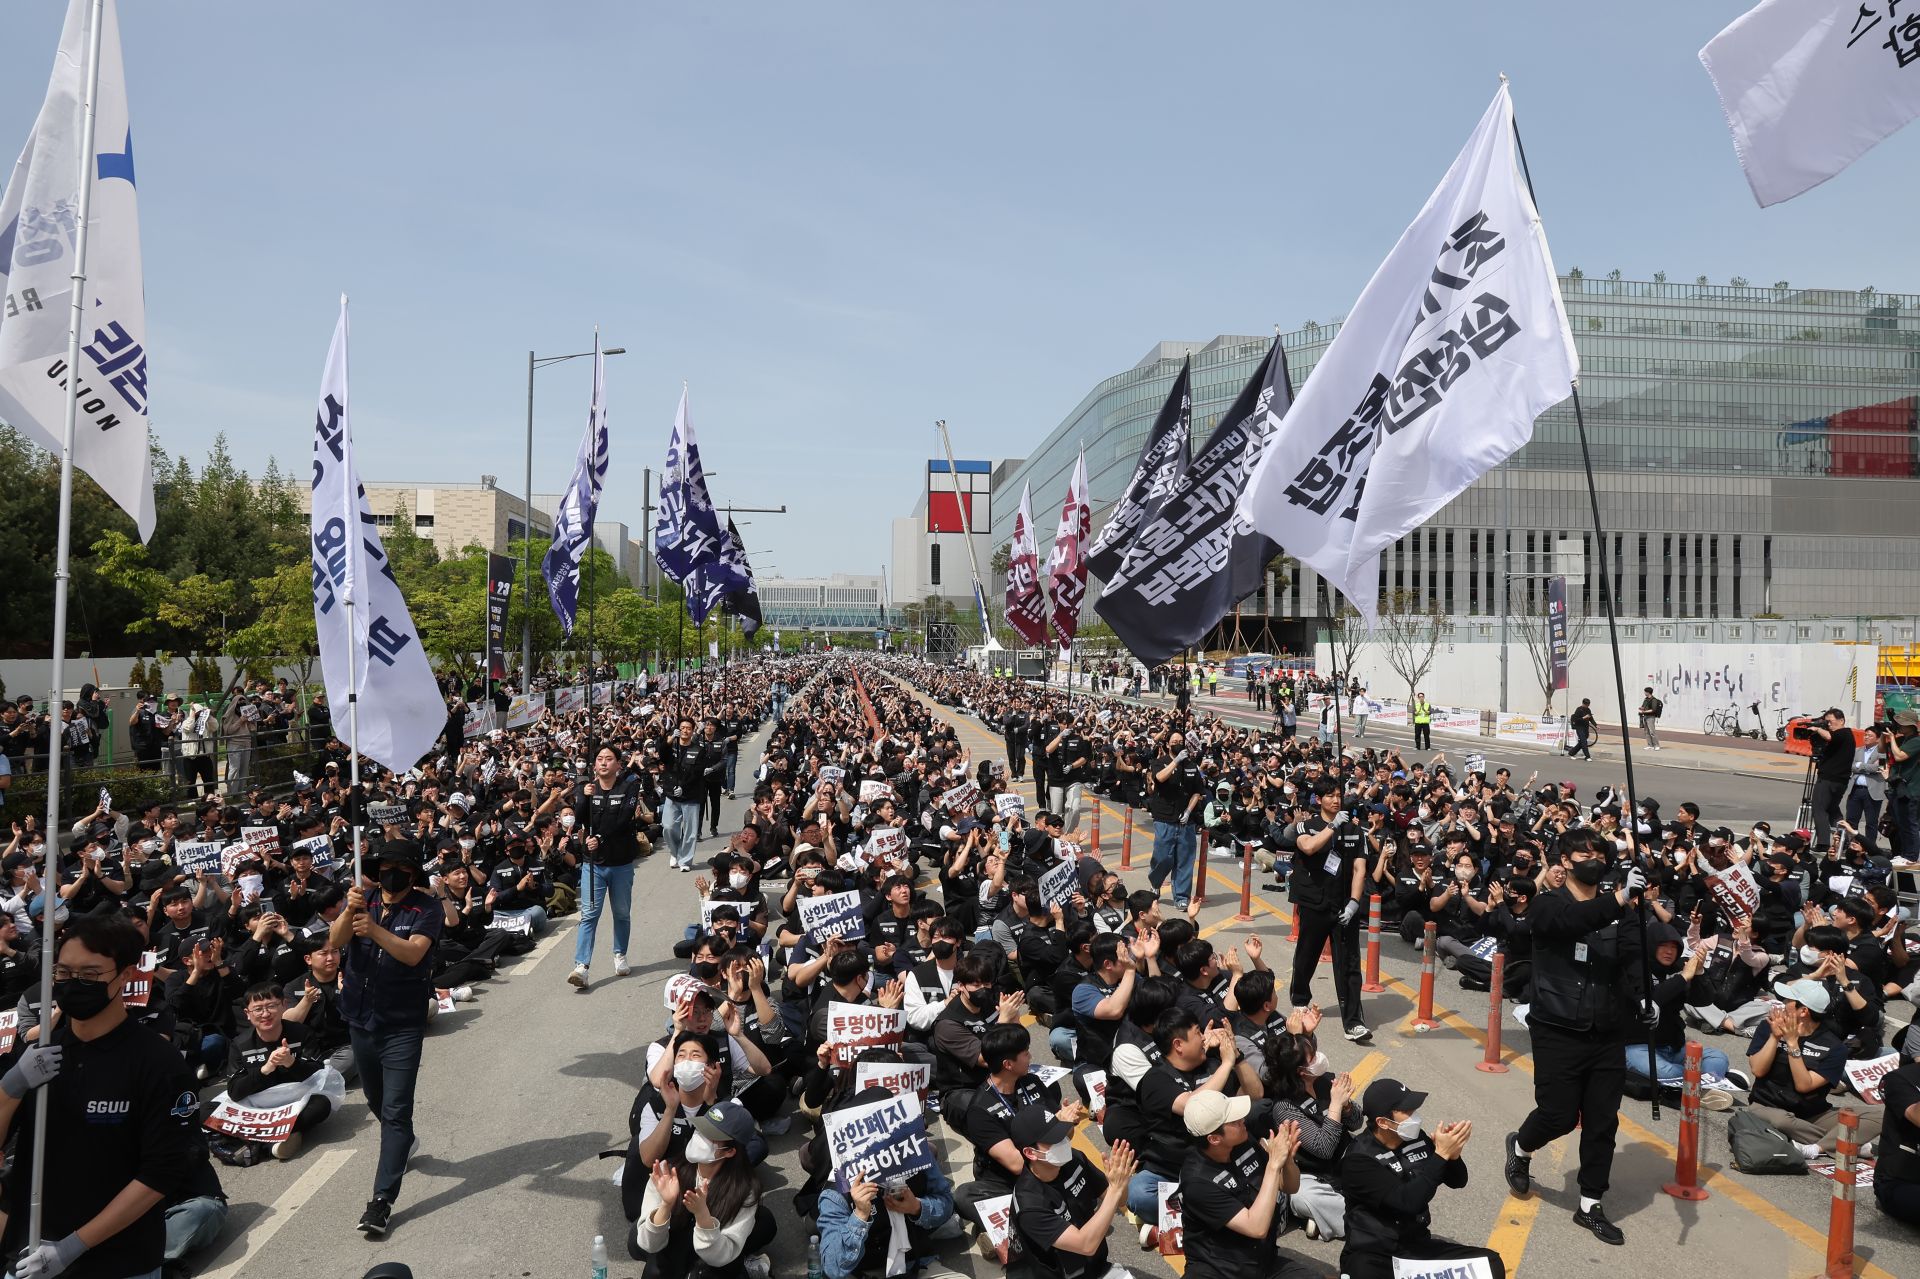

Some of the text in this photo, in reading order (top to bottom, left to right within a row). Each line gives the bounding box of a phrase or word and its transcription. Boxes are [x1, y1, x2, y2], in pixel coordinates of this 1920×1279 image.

[245, 828, 274, 841] 투명하게
[178, 844, 214, 860] 상한폐지
[803, 894, 852, 923] 상한폐지
[813, 915, 864, 944] 실현하자
[833, 1013, 900, 1035] 투명하게
[1851, 1056, 1899, 1084] 투명하게
[87, 1100, 130, 1115] SGUU
[224, 1104, 294, 1123] 투명하게
[221, 1122, 291, 1138] 바꾸고!!!
[833, 1099, 908, 1154] 상한폐지
[1408, 1151, 1428, 1163] SELU
[1243, 1160, 1259, 1177] SELU
[1072, 1177, 1086, 1197] SELU
